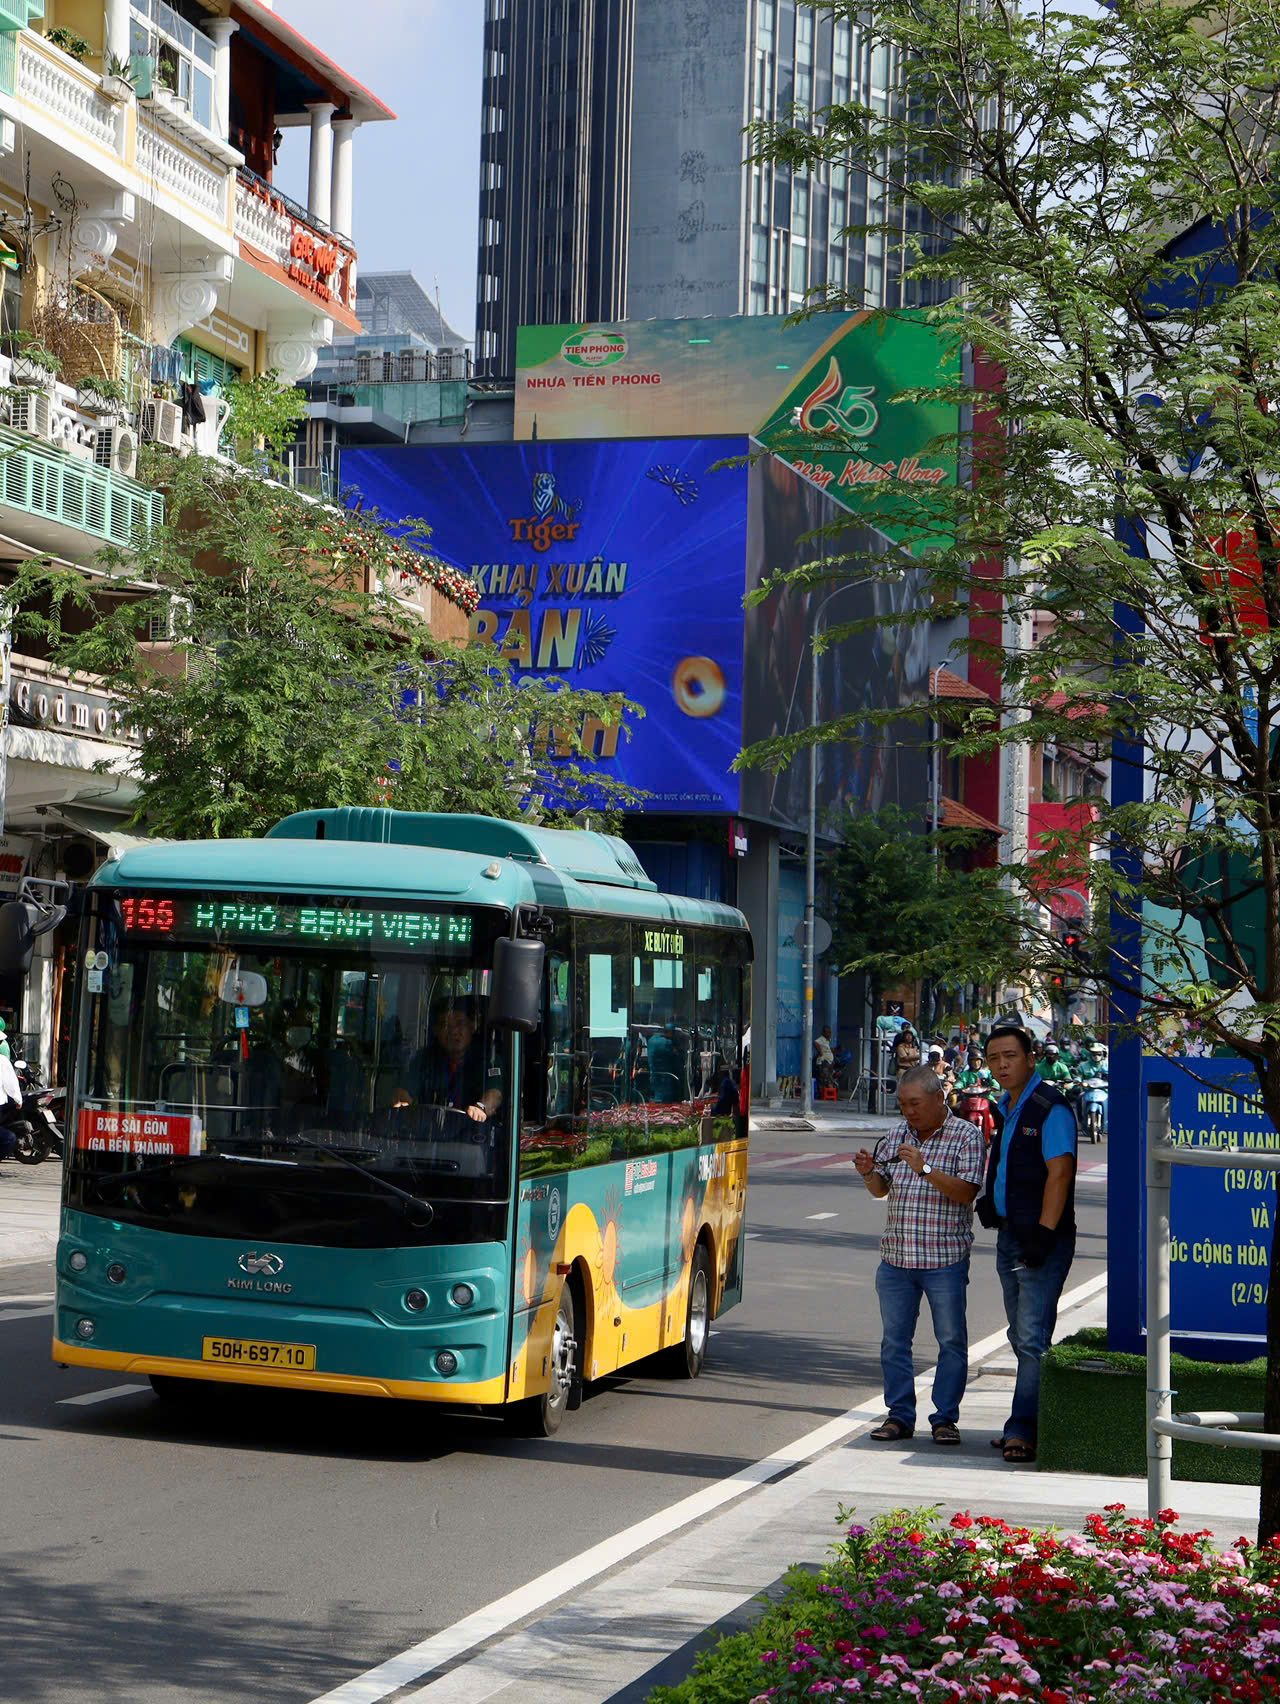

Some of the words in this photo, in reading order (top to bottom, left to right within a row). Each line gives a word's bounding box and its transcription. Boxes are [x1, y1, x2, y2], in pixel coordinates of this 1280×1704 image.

[589, 344, 625, 353] PHONG
[527, 375, 566, 390] NHỰA
[611, 373, 661, 386] PHONG
[546, 554, 628, 596] XUÂN
[448, 917, 471, 942] N
[645, 930, 653, 951] XE
[1198, 1092, 1237, 1118] NHIỆT
[1243, 1088, 1265, 1119] LIỆ
[97, 1117, 118, 1131] BXB
[122, 1116, 140, 1133] SÀI
[143, 1118, 168, 1135] GÒN
[1199, 1124, 1238, 1147] CÁCH
[88, 1138, 106, 1151] (GA
[109, 1135, 130, 1153] BẾN
[134, 1138, 174, 1155] THÀNH)
[1251, 1202, 1270, 1228] VÀ
[1193, 1238, 1233, 1268] CỘNG
[1237, 1240, 1268, 1266] HÒA
[227, 1277, 253, 1290] KIM
[257, 1280, 292, 1294] LONG
[211, 1341, 305, 1366] 50H-697.10
